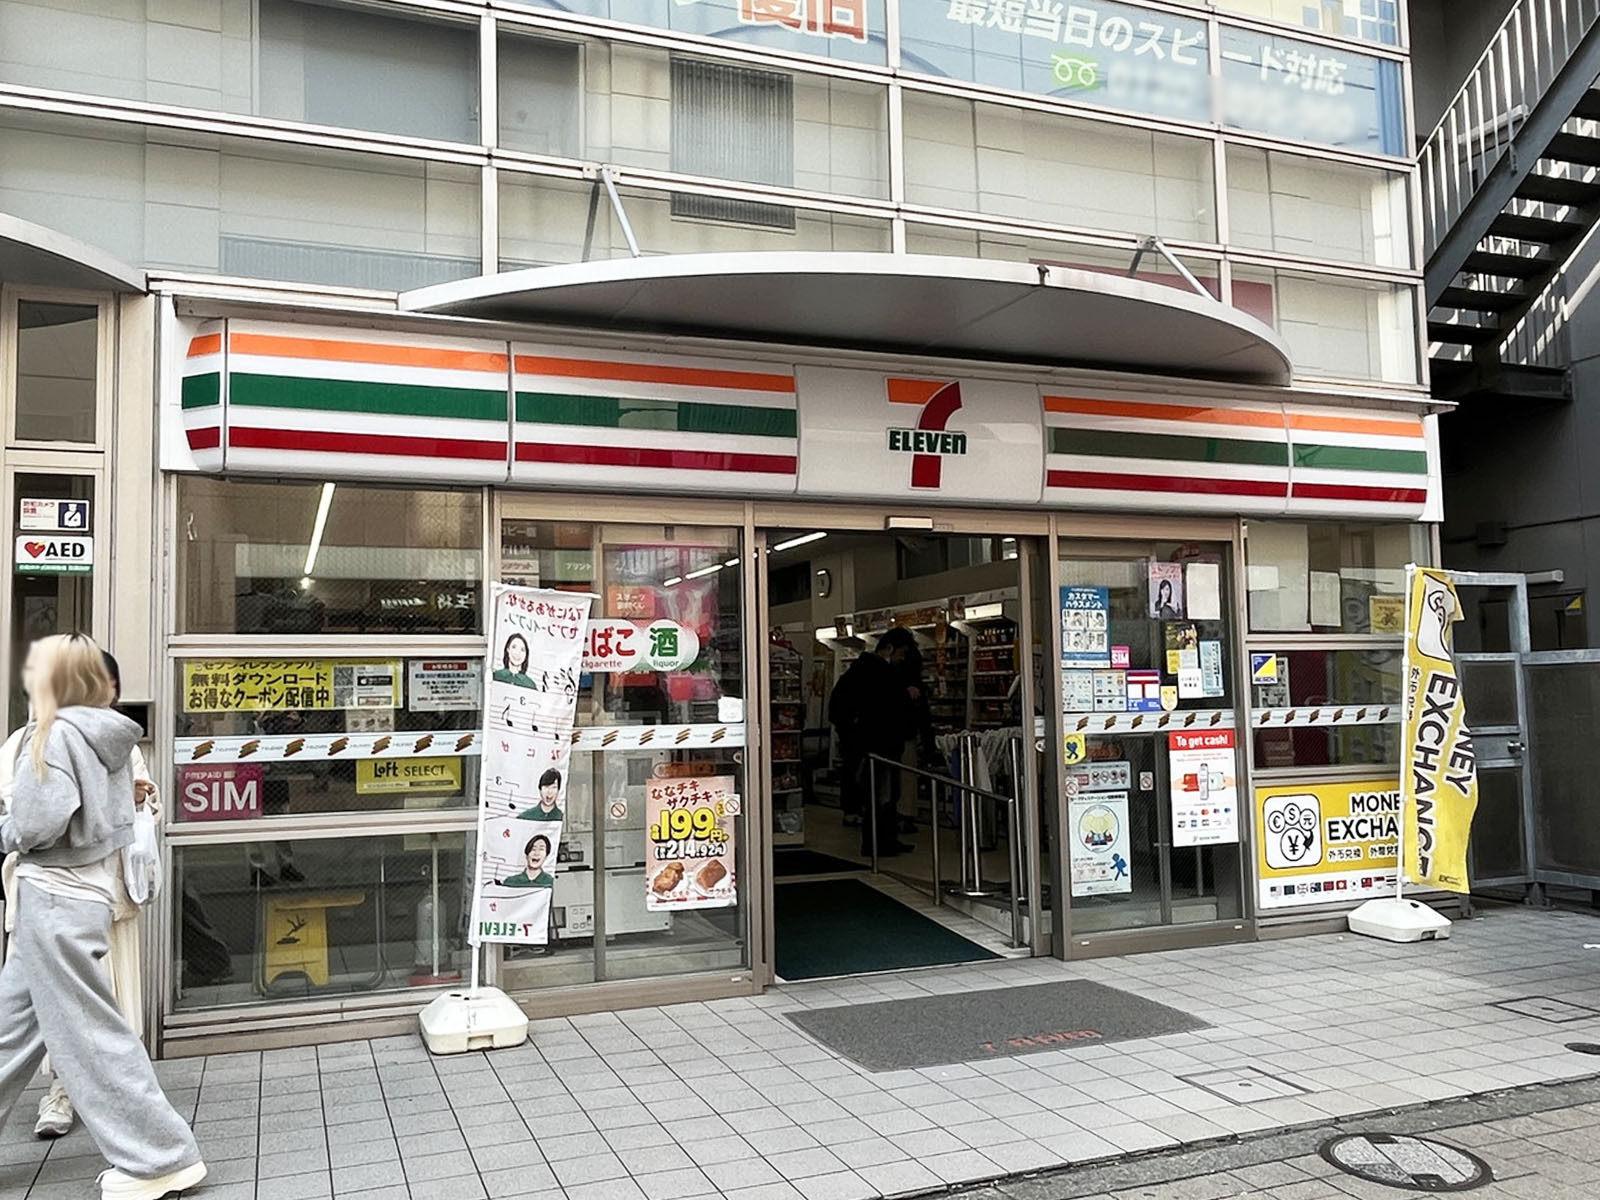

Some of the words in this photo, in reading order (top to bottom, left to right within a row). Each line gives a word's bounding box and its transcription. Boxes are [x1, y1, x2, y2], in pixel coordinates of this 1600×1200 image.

[885, 378, 962, 488] 7
[45, 542, 85, 557] AED
[649, 627, 679, 657] 酒
[653, 660, 680, 668] liquor
[1111, 653, 1129, 664] SIM
[191, 672, 328, 687] 無料ダウンロード
[189, 686, 330, 709] お得なクーポン配信中
[1176, 736, 1187, 747] To
[1189, 737, 1203, 748] get
[374, 761, 398, 778] Loft
[404, 765, 445, 777] SELECT
[184, 781, 257, 812] SIM
[1351, 793, 1399, 812] MONE
[1328, 816, 1399, 840] EXCHA
